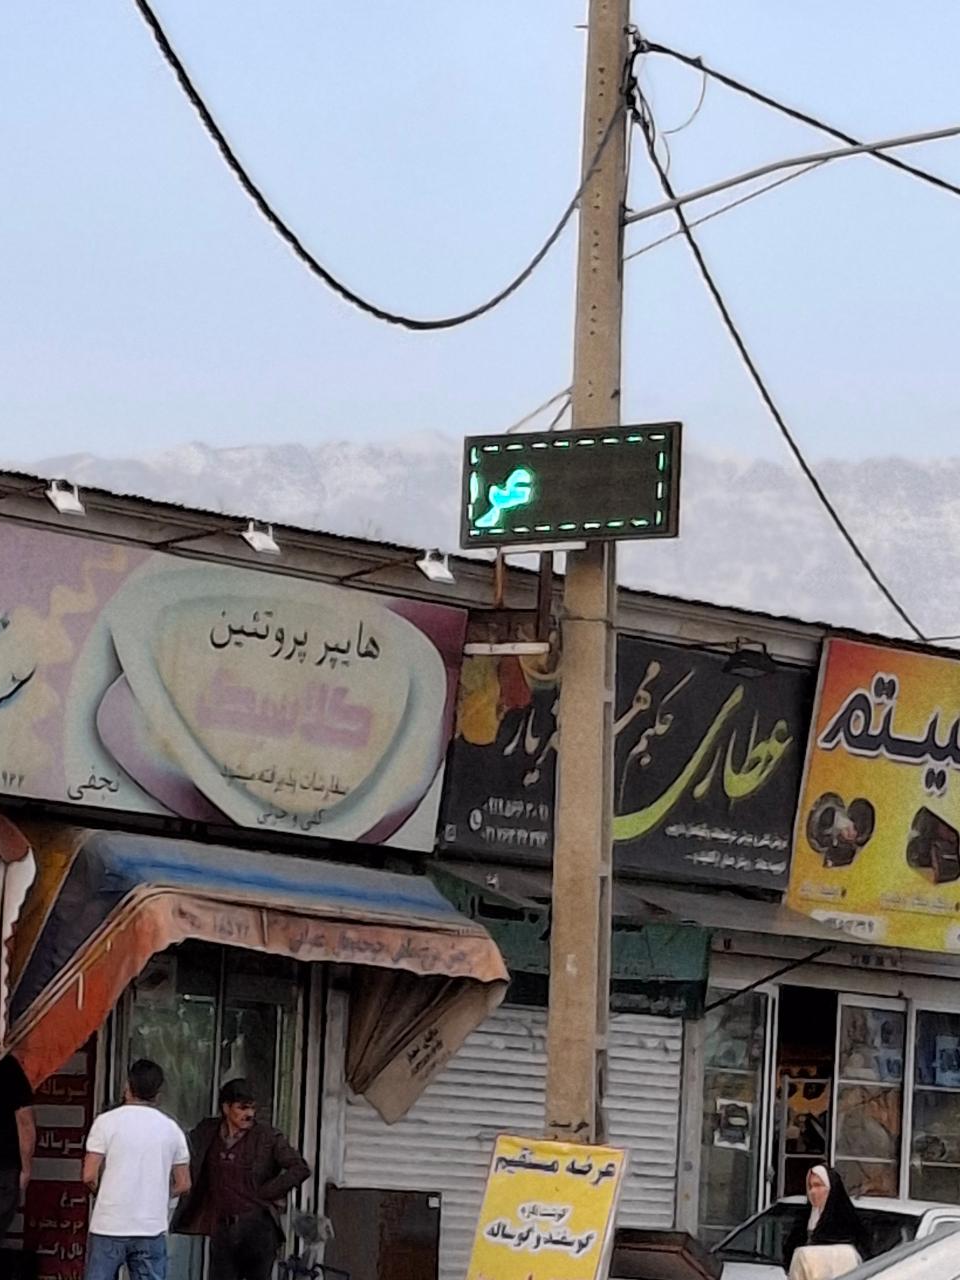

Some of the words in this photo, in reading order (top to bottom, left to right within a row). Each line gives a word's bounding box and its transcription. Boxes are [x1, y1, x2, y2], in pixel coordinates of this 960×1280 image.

[210, 610, 308, 663] پروتئین
[318, 620, 381, 669] هایپر
[67, 764, 121, 801] نجفی
[494, 1147, 560, 1173] مستقیم
[566, 1154, 616, 1185] عرضه
